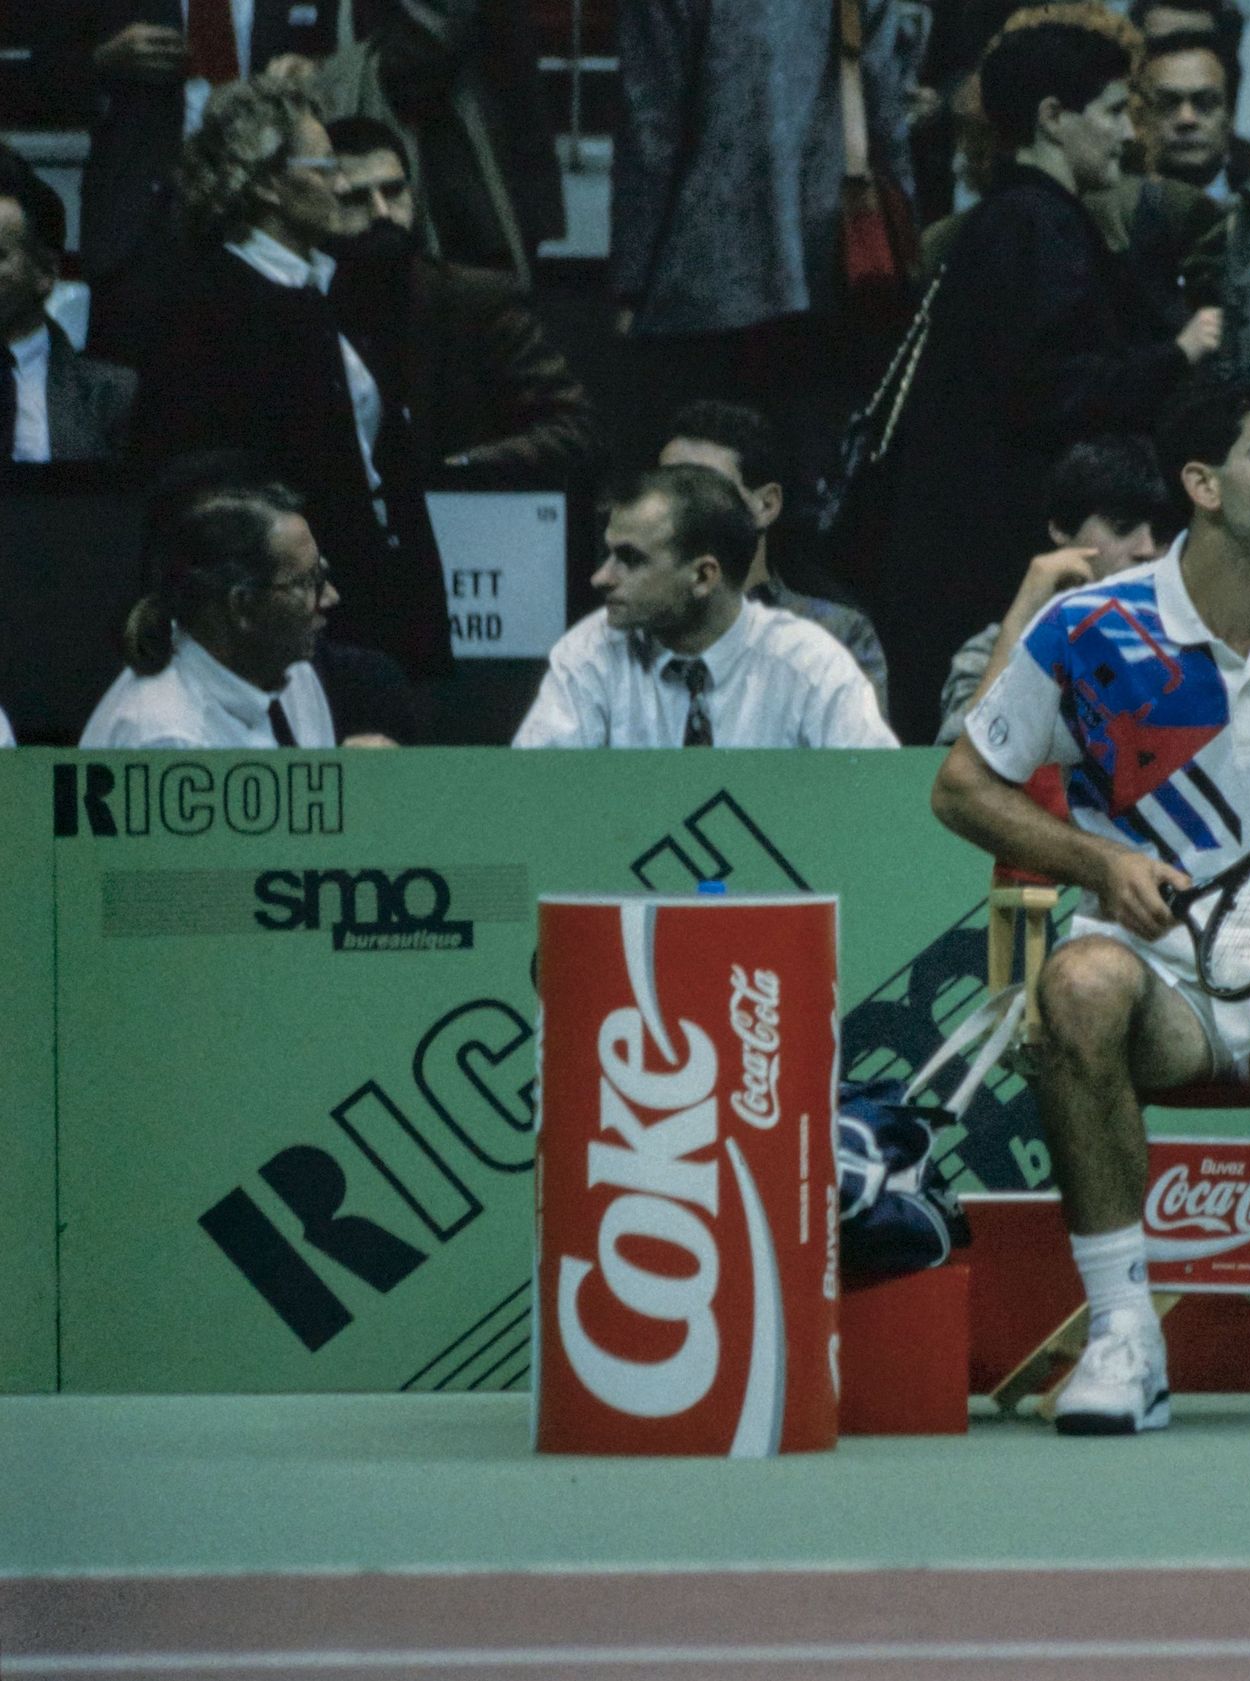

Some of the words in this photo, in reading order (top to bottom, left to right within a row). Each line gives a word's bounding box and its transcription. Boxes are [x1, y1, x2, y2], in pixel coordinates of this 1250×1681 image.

[452, 569, 502, 599] ETT
[450, 612, 504, 641] ARD
[53, 763, 344, 837] RICOH
[730, 964, 781, 1130] Coca-Cola
[1200, 1156, 1246, 1176] Buvez
[557, 1006, 721, 1418] Coke
